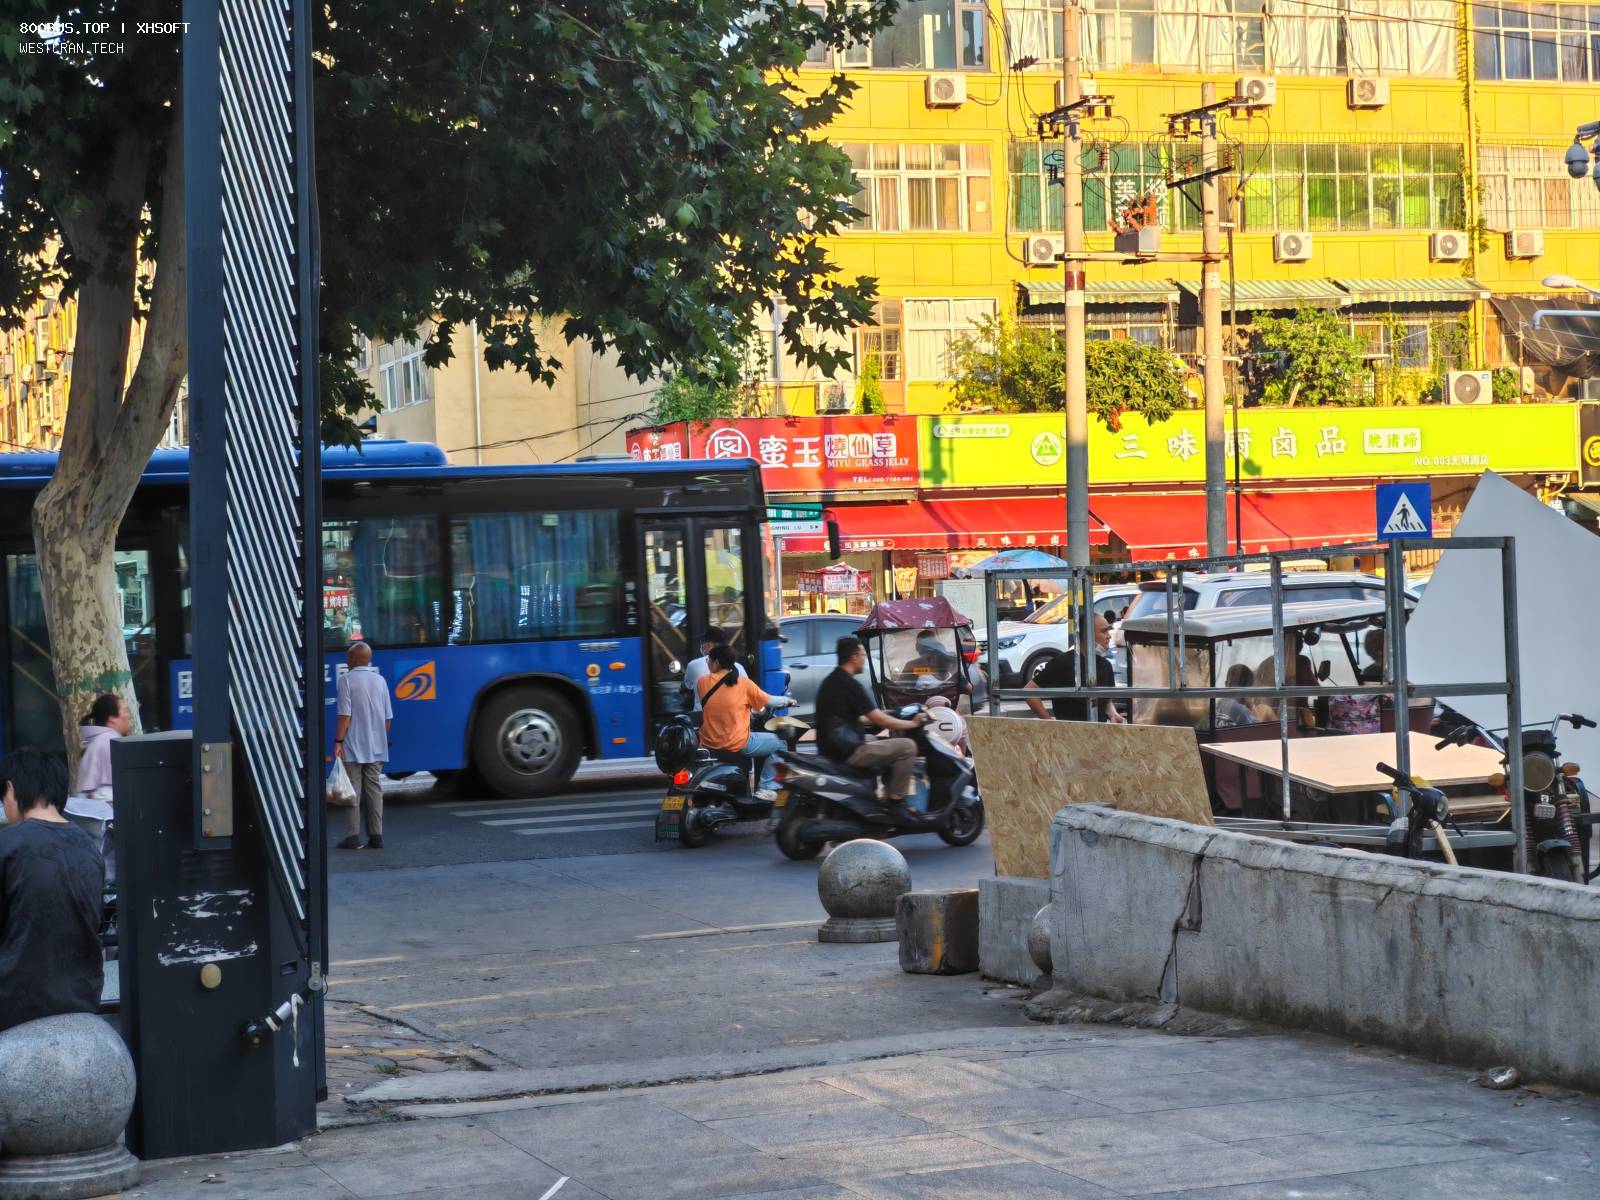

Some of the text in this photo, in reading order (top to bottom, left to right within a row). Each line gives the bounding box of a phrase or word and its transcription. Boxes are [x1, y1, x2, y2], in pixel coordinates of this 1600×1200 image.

[758, 435, 823, 469] 蜜玉
[827, 457, 910, 468] MIYU GRASS JELLY
